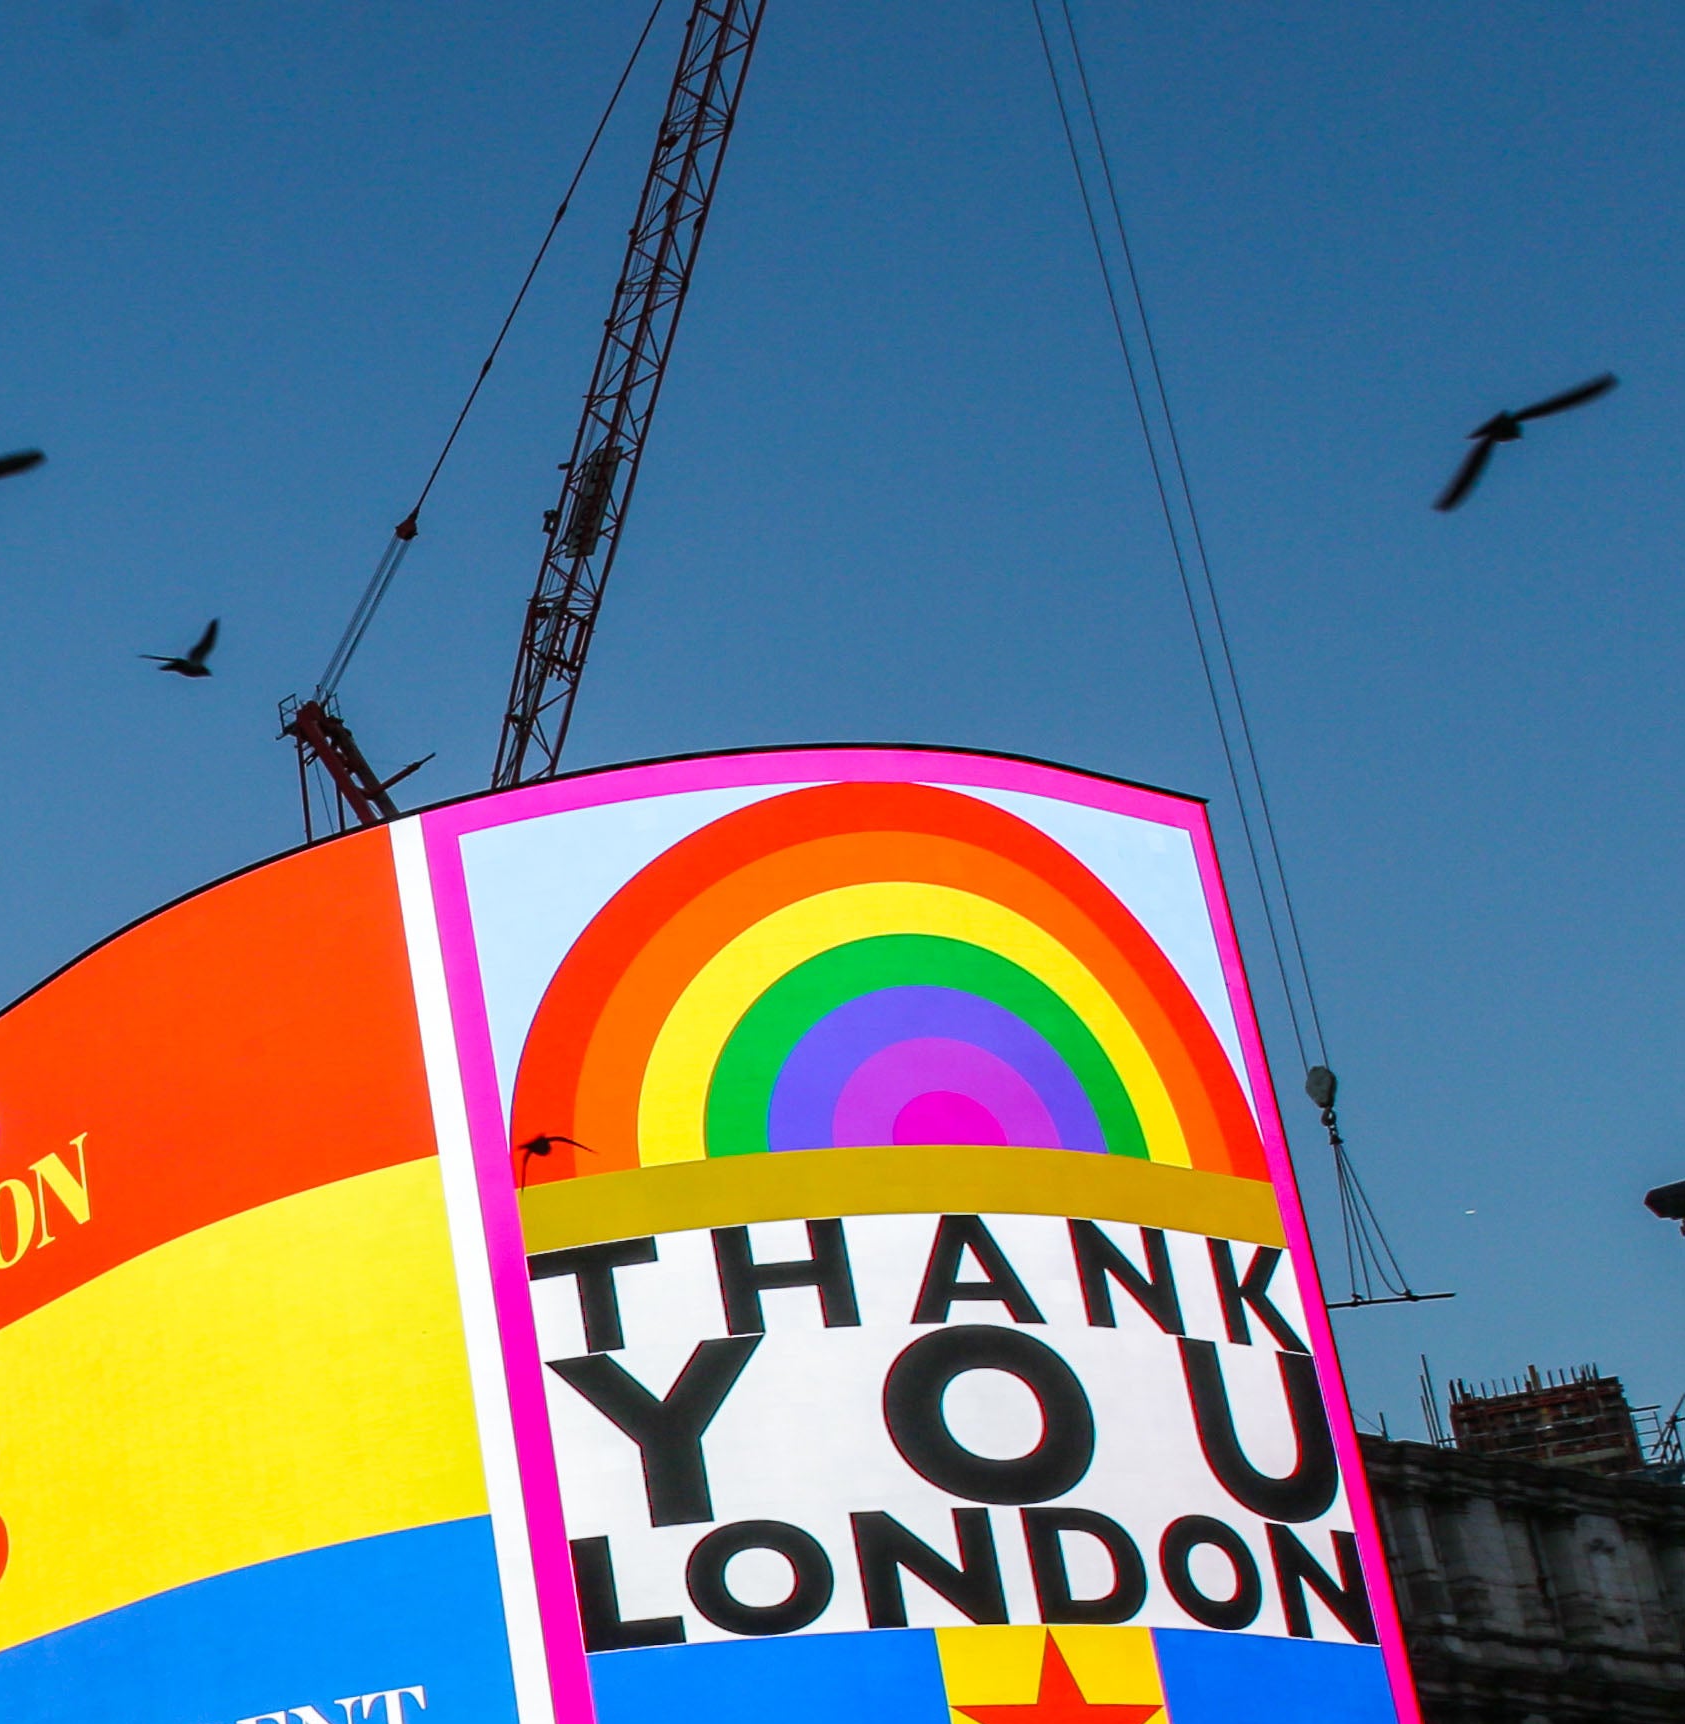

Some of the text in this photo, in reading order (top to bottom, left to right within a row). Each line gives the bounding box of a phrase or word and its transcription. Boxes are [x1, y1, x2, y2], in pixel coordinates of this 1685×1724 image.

[528, 1214, 1314, 1356] THANK
[544, 1325, 1339, 1527] YOU
[569, 1506, 1381, 1652] LONDON
